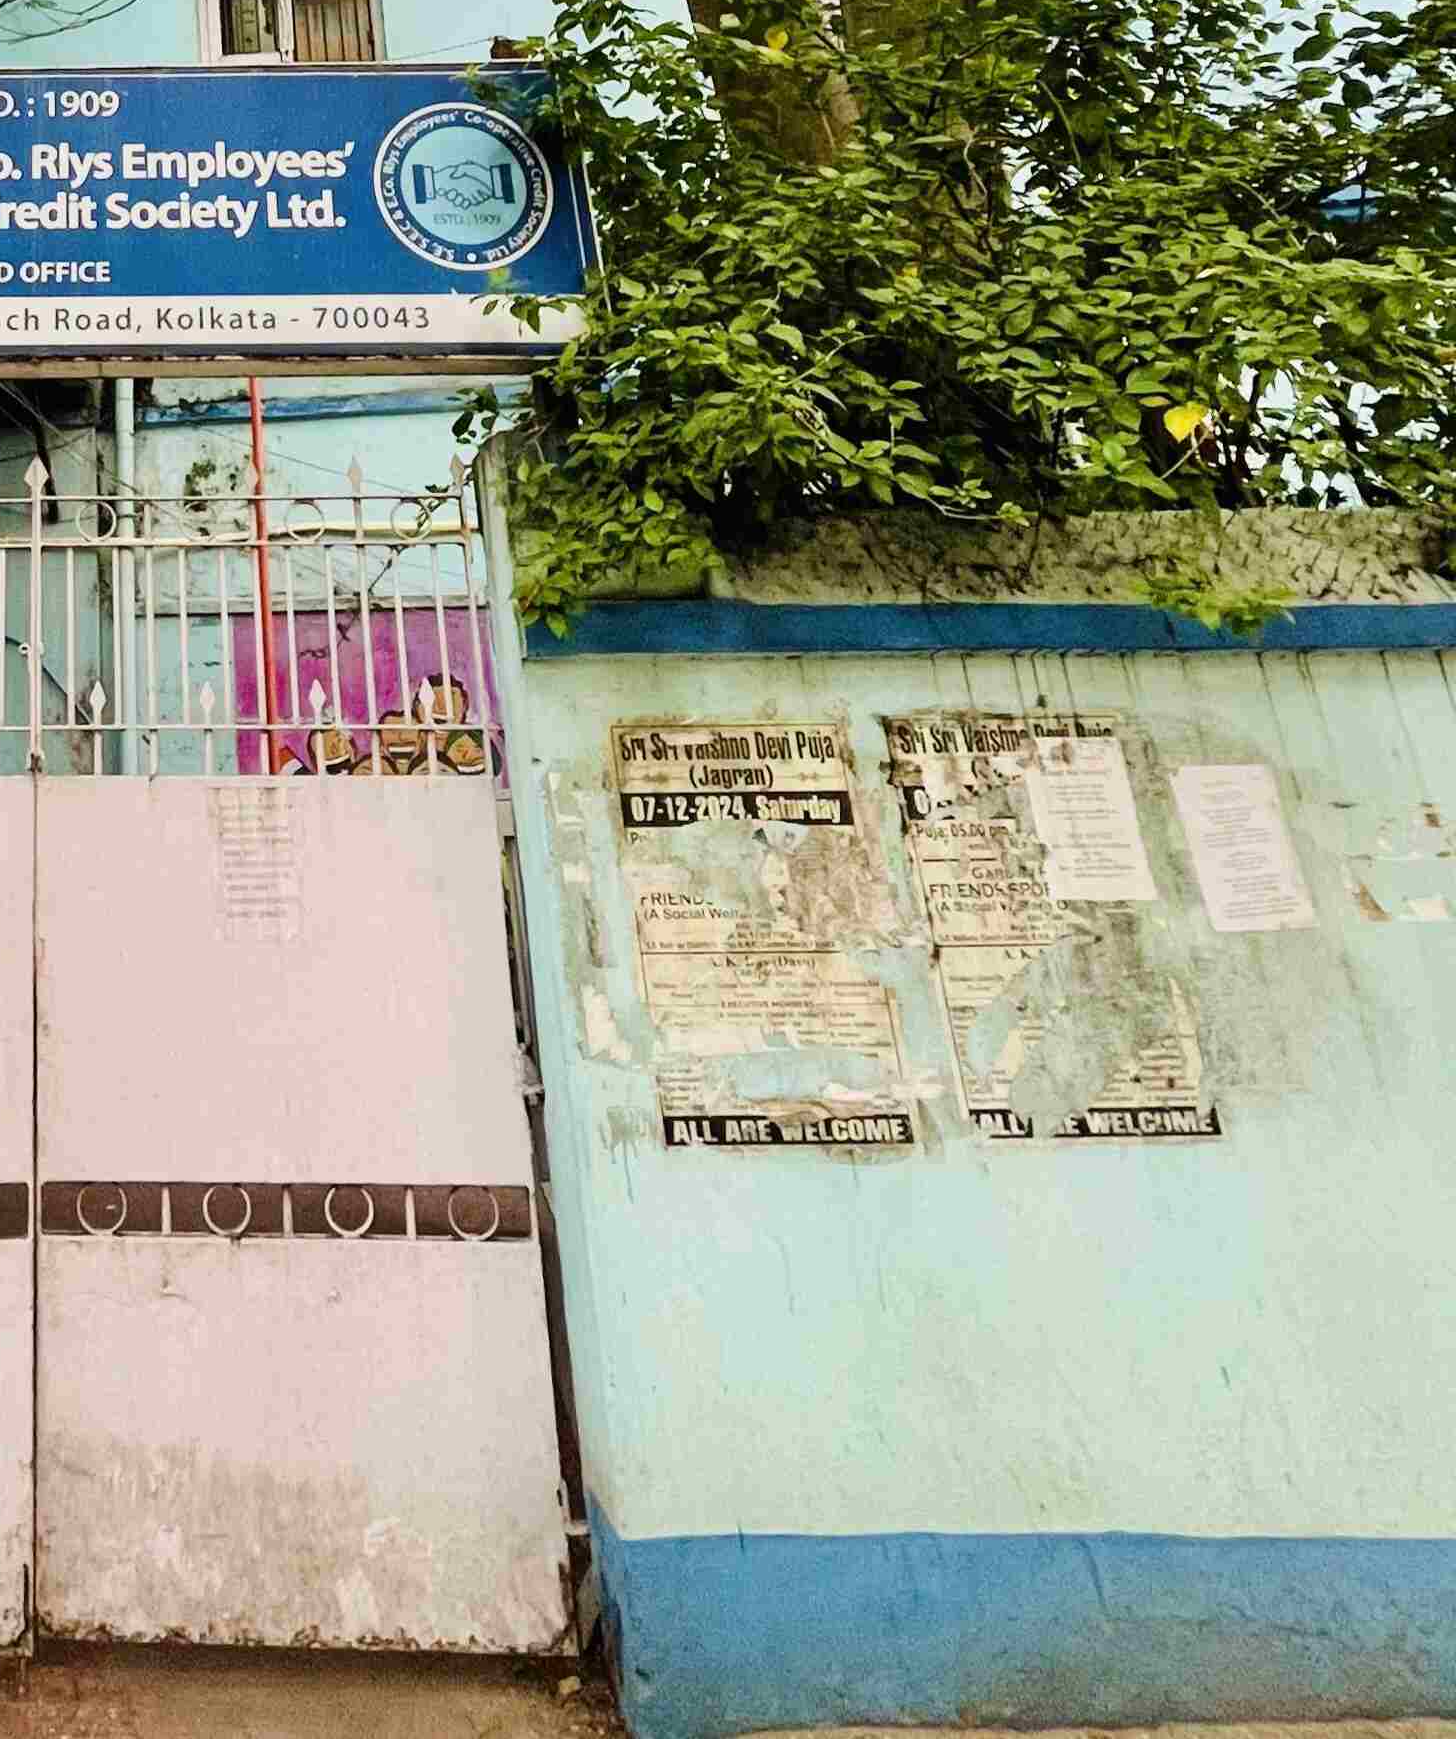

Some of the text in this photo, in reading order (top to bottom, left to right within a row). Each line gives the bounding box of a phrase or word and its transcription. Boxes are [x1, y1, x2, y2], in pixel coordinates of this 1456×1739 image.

[43, 91, 120, 117] 1909
[31, 142, 113, 188] Rlys
[121, 141, 355, 187] Employees'
[105, 192, 258, 239] Society
[265, 189, 347, 229] Ltd.
[19, 261, 111, 283] OFFICE
[55, 307, 142, 333] Road,
[156, 307, 277, 330] Kolkata
[312, 307, 431, 329] 700043
[754, 731, 792, 760] Devi
[796, 731, 835, 763] Puja
[898, 725, 926, 754] Sri
[930, 723, 957, 753] Sri
[688, 764, 774, 789] (Jagran)
[756, 795, 842, 823] Saturday
[928, 882, 1008, 898] FRENDS
[673, 1118, 908, 1143] ALL ARE WELCOME
